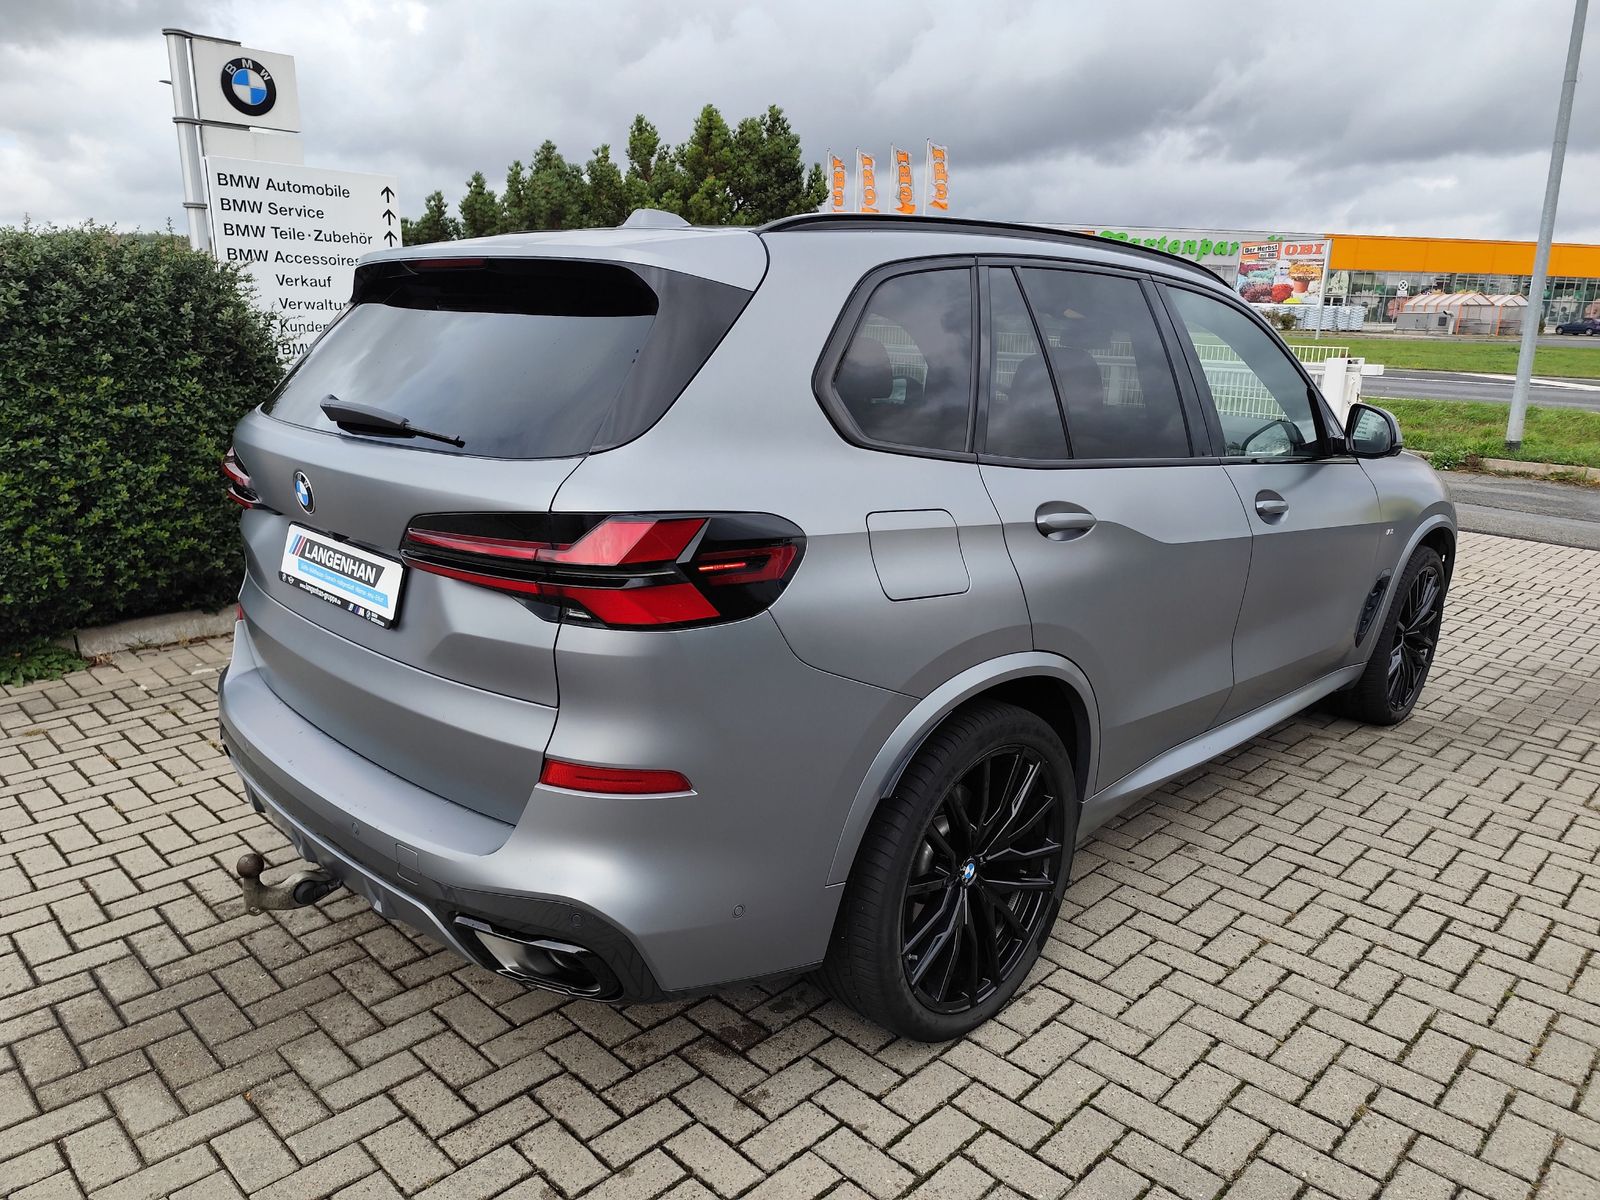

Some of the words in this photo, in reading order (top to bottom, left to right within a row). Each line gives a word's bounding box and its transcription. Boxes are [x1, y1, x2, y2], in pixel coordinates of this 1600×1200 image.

[225, 58, 271, 82] BMW
[217, 172, 260, 189] BMW
[265, 178, 350, 198] Automobile
[220, 198, 263, 214] BMW
[268, 202, 324, 219] Service
[223, 223, 266, 238] BMW
[226, 248, 269, 263] BMW
[1284, 243, 1325, 256] OBI
[275, 274, 332, 288] Verkauf
[304, 541, 377, 584] LANGENHAN
